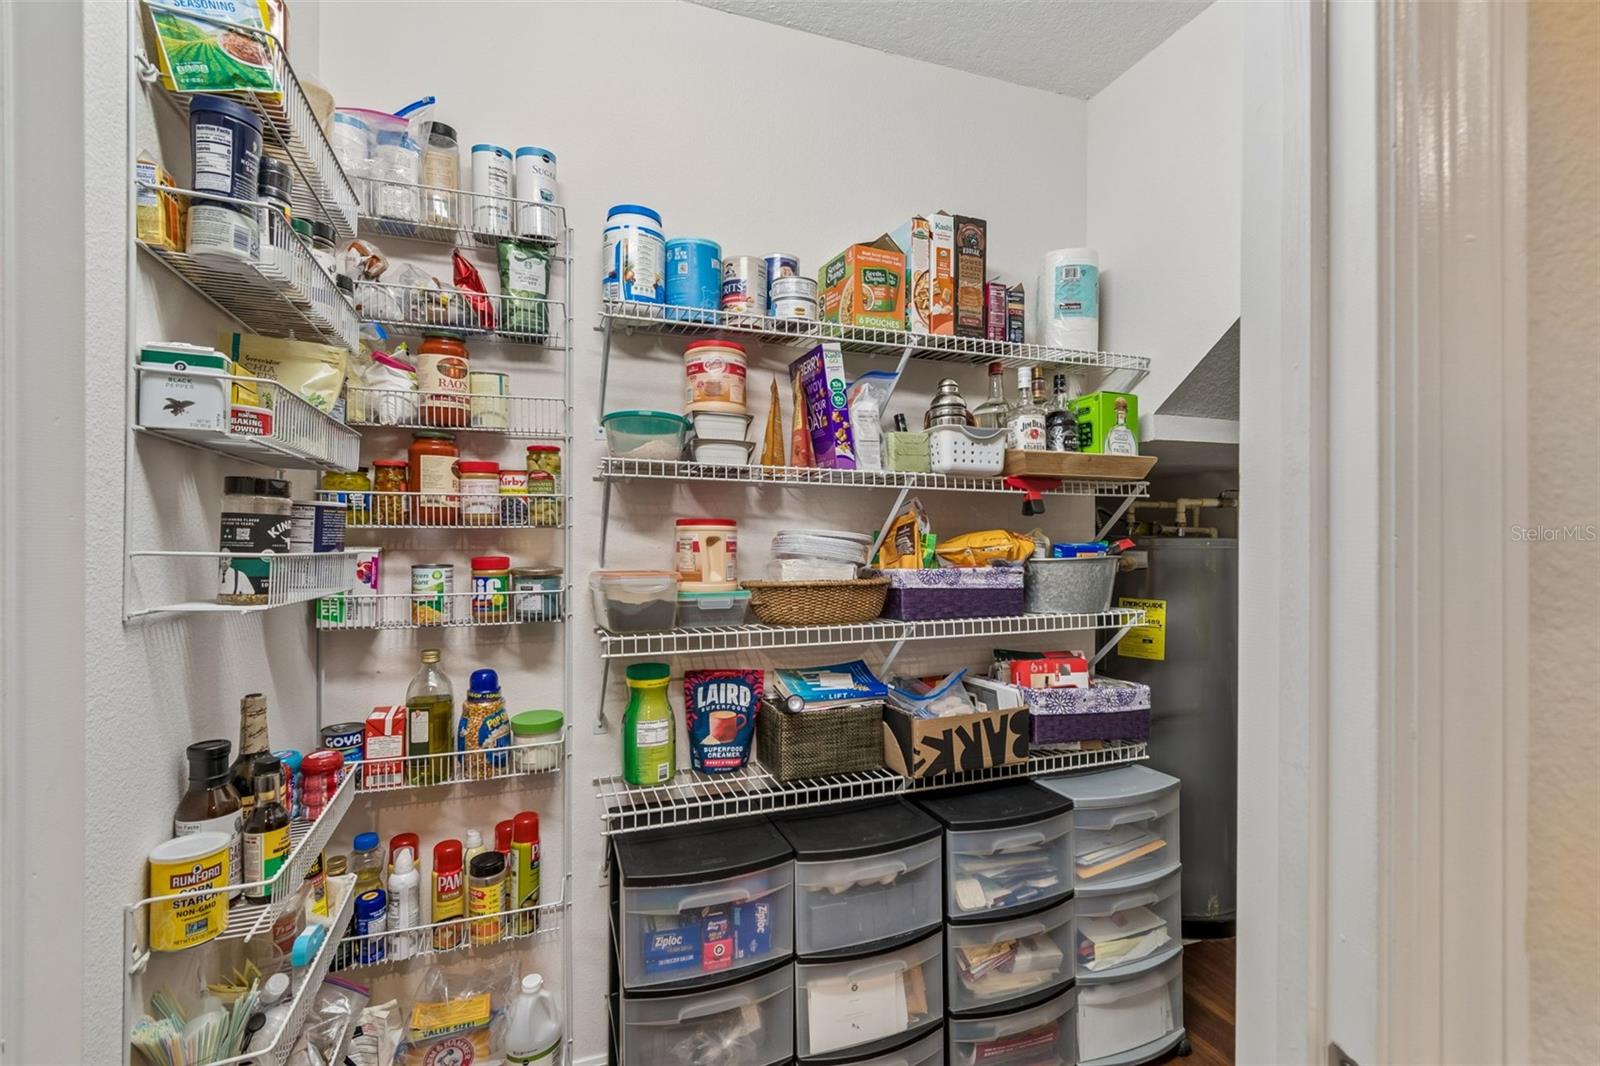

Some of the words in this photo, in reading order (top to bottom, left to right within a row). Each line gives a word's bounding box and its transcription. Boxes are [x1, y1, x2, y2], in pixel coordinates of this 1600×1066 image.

[174, 0, 236, 12] SEASONING
[723, 283, 743, 294] RITS
[167, 376, 192, 384] BLACK
[231, 417, 263, 427] BAKING
[1020, 421, 1033, 433] JIM
[697, 683, 752, 708] LAIRD
[828, 692, 848, 700] LIFT
[325, 734, 362, 748] GOYA
[172, 865, 220, 888] RUMFORD
[438, 874, 464, 892] PAM
[176, 901, 217, 919] NON-GMO
[654, 935, 683, 950] Ziploc
[422, 1026, 452, 1039] VALUE
